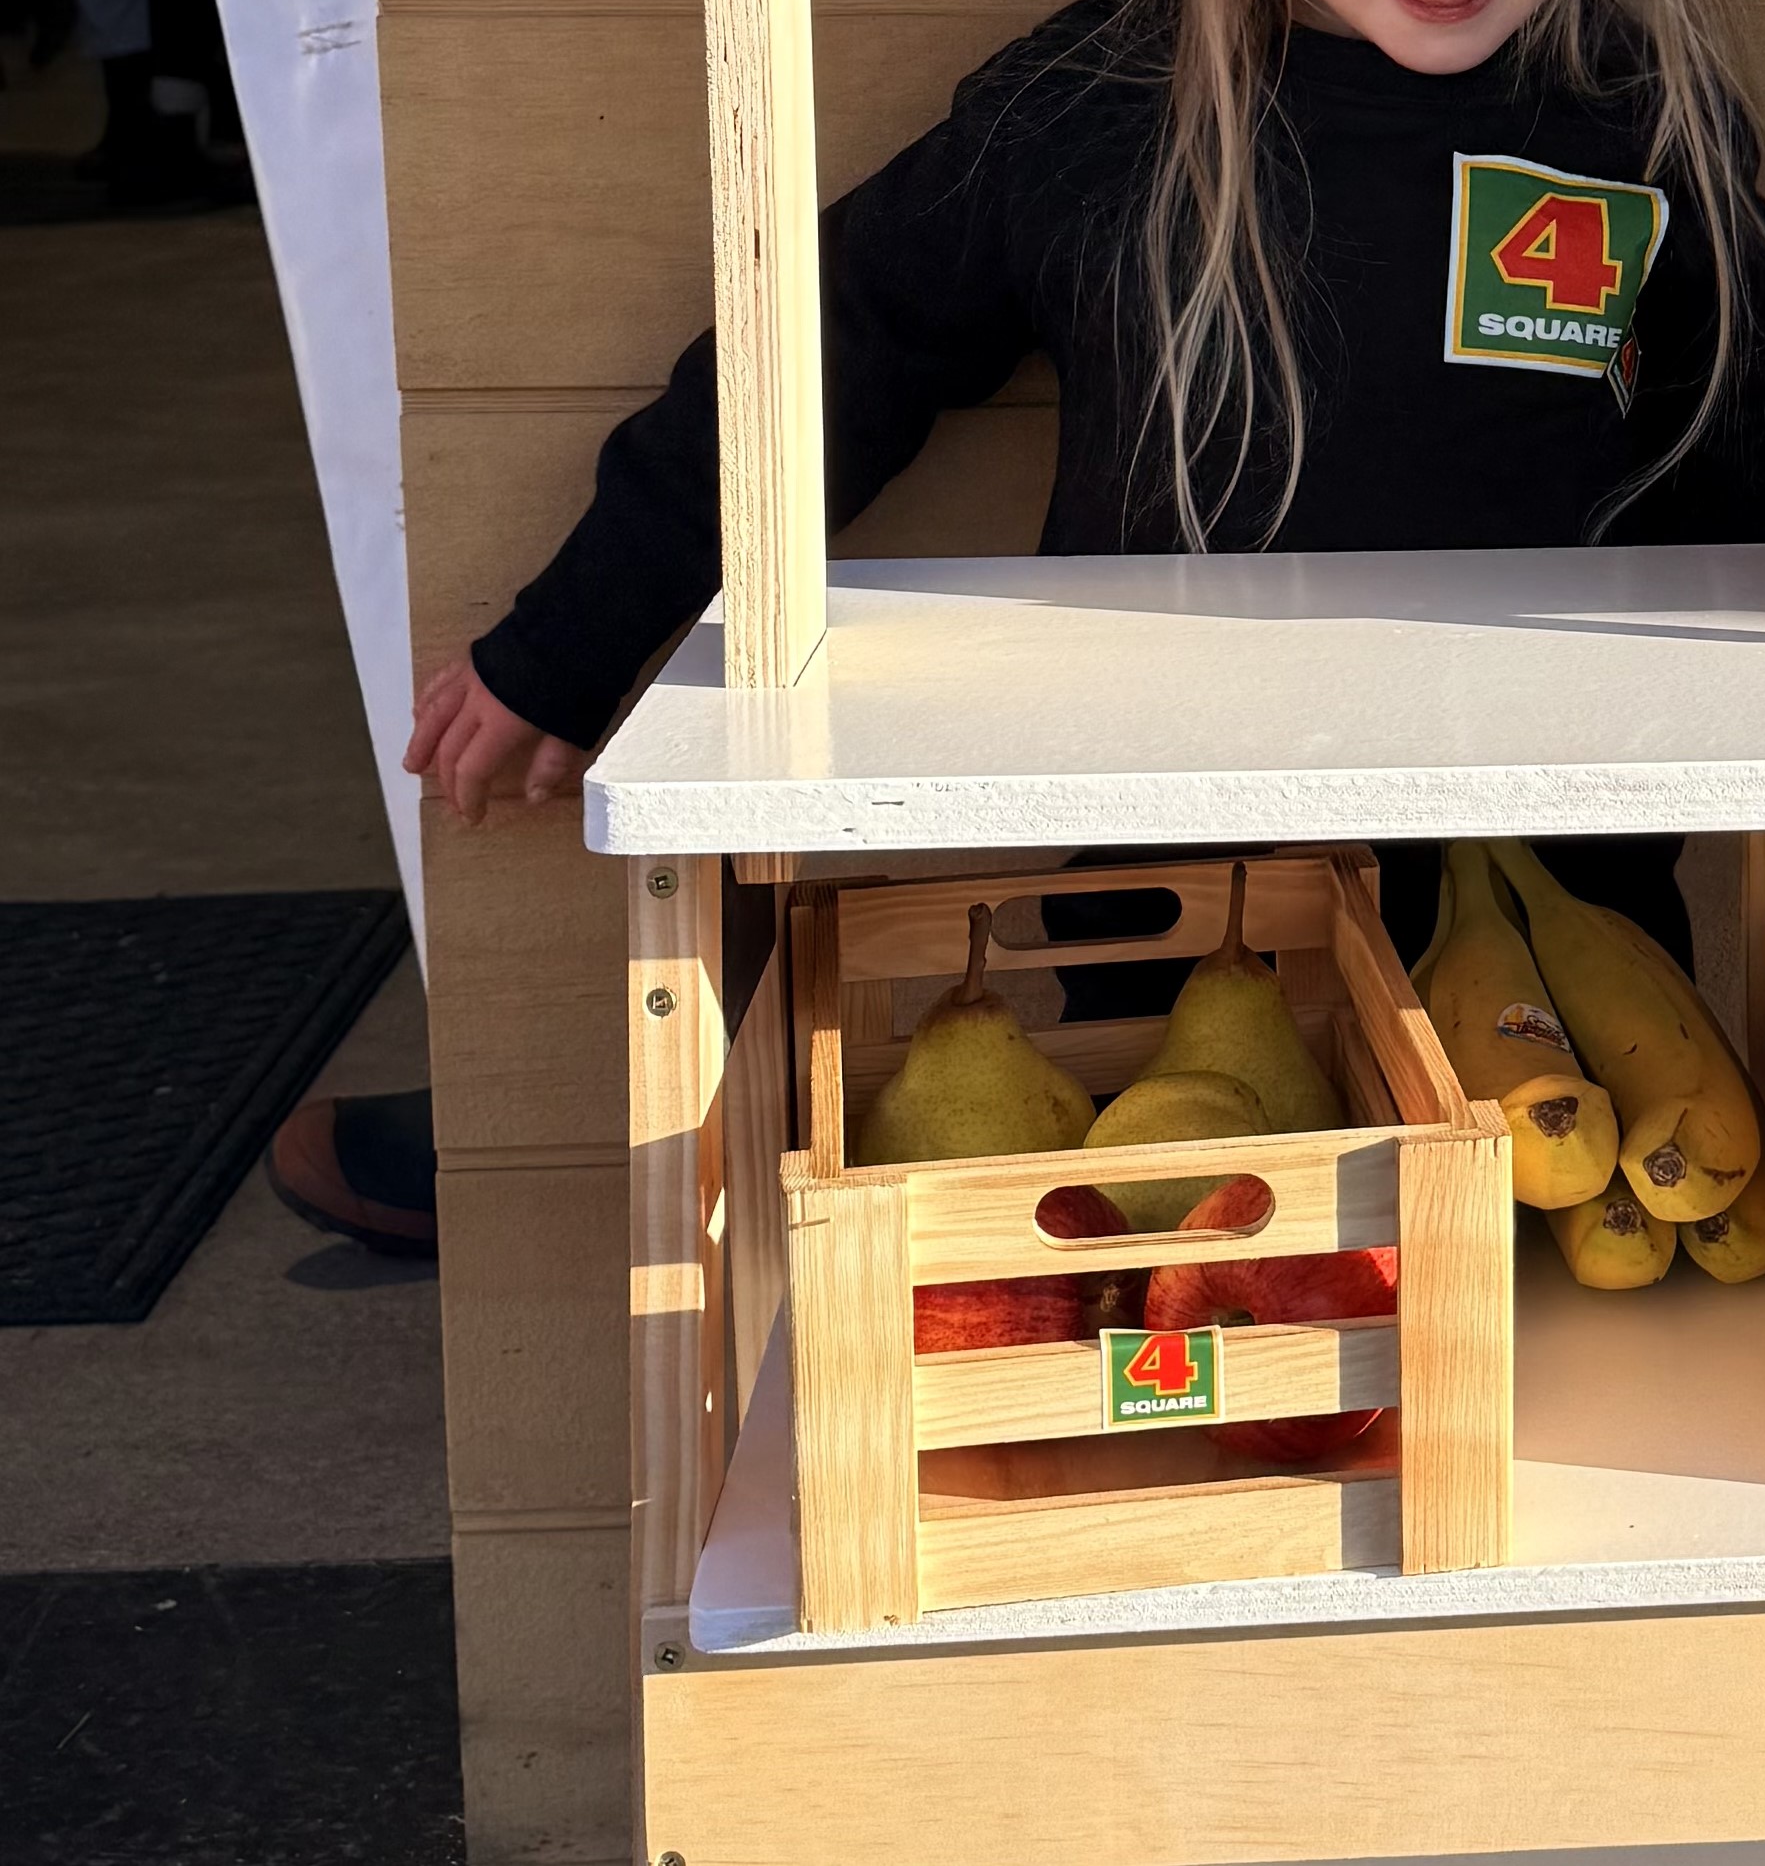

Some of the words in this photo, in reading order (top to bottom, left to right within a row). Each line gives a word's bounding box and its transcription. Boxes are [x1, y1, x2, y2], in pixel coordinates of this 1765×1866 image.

[1490, 192, 1622, 314] 4
[1478, 313, 1622, 348] SQUARE
[1123, 1333, 1198, 1395] 4
[1120, 1395, 1207, 1415] SQUARE
